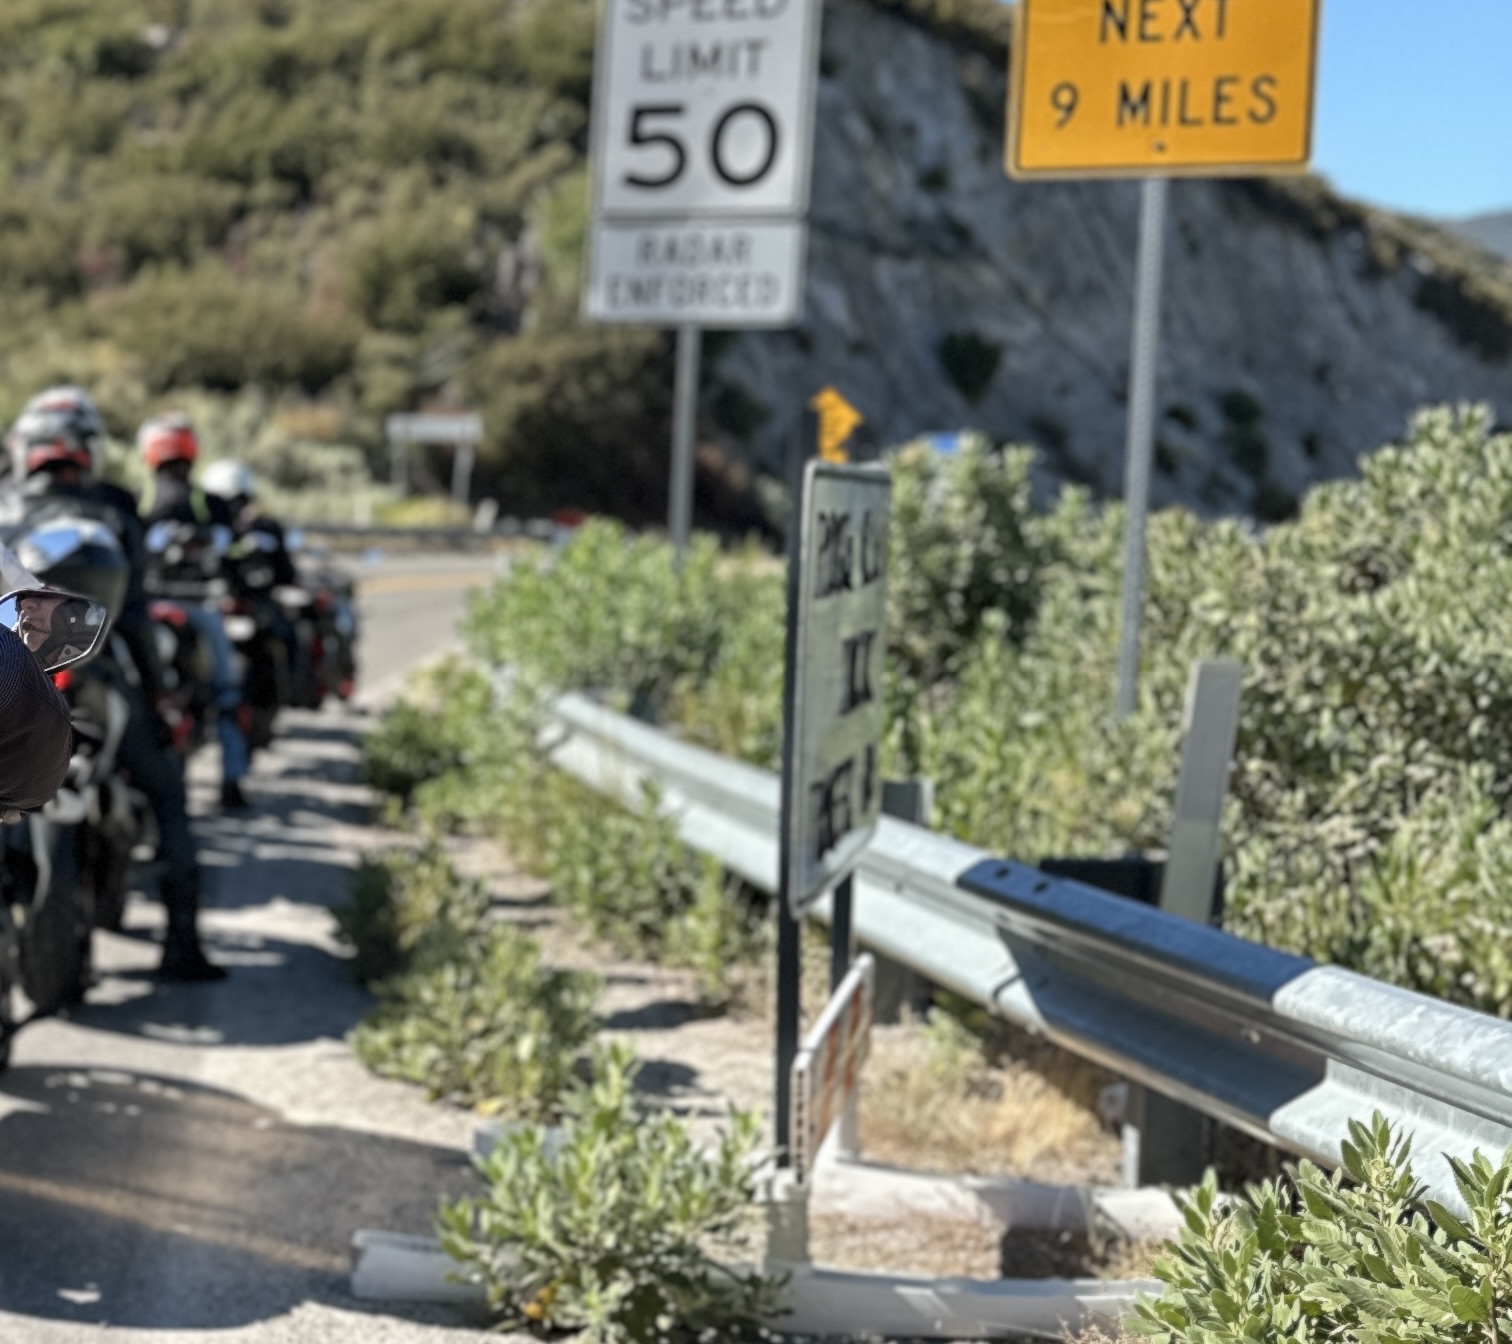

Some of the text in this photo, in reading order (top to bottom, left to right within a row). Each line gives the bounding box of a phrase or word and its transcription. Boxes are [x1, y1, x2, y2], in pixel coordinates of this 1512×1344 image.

[639, 36, 766, 84] LIMIT
[1050, 73, 1280, 129] 9 MILES
[624, 101, 780, 190] 50
[636, 232, 753, 267] RADAR
[606, 271, 781, 310] ENFORCED
